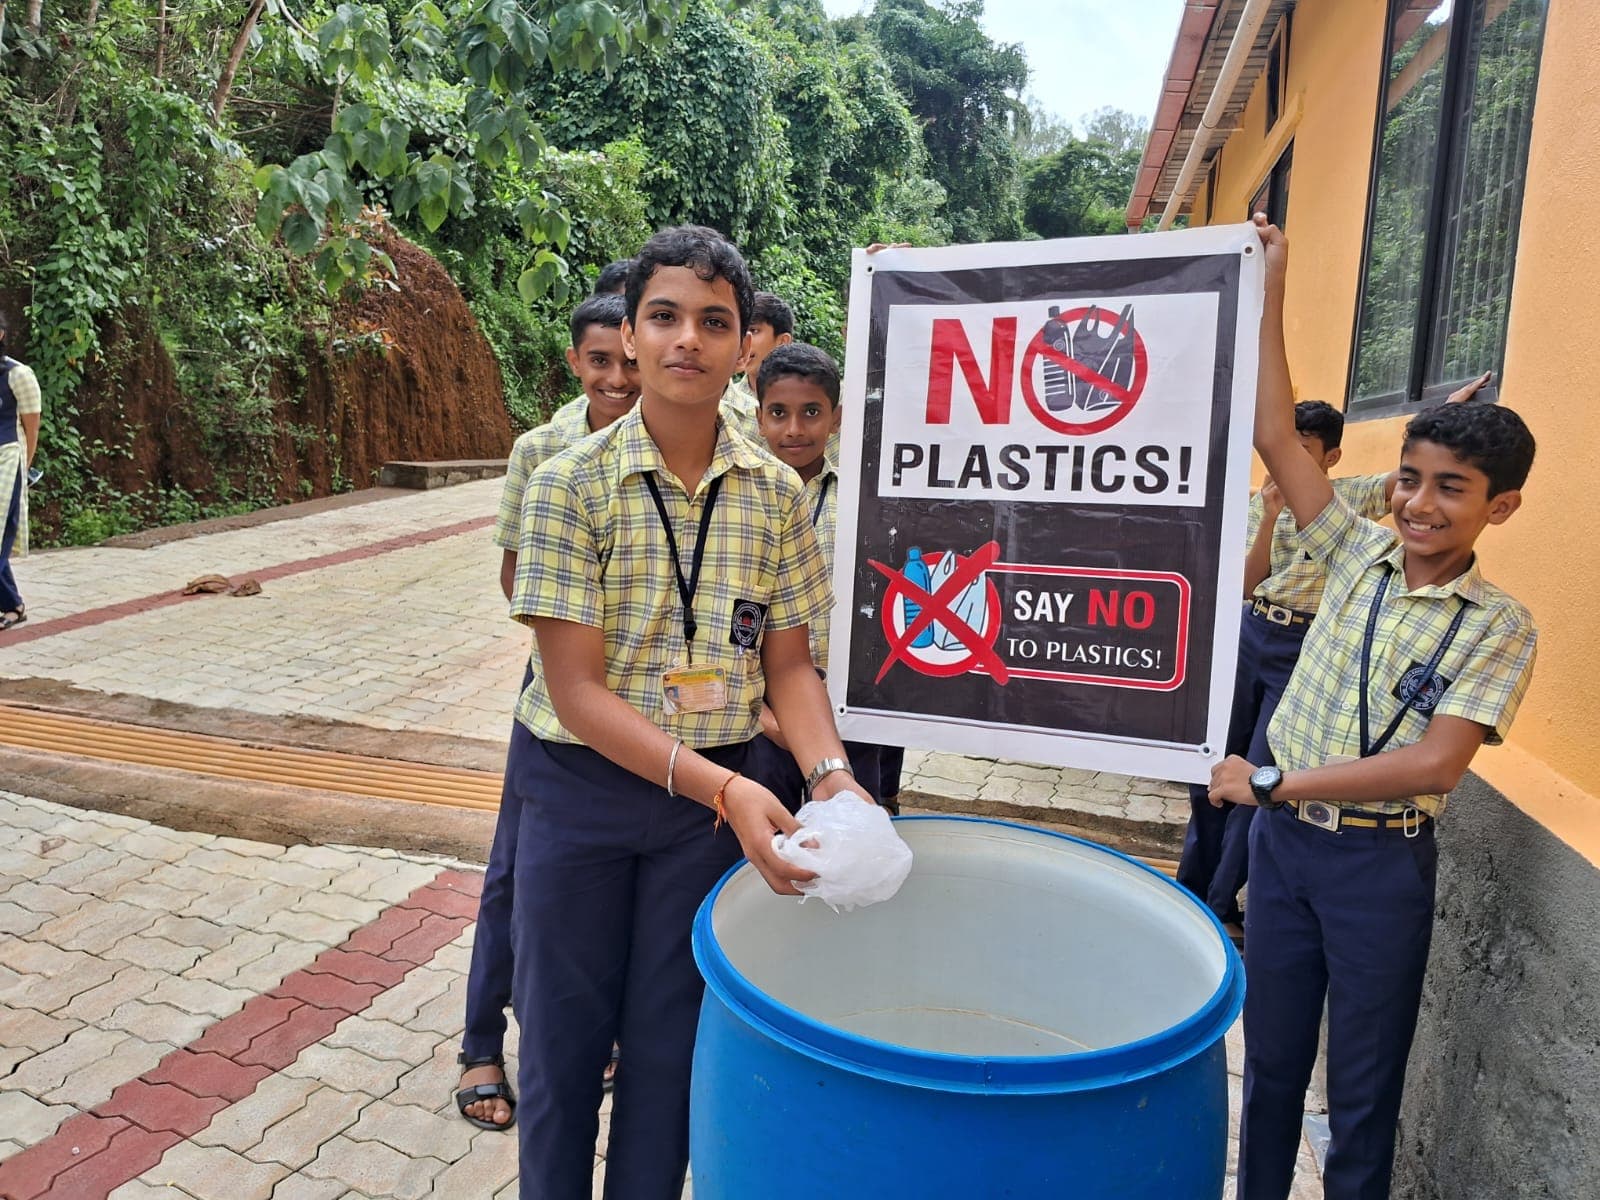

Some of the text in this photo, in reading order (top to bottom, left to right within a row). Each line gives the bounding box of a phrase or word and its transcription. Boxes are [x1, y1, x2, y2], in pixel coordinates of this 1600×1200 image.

[891, 443, 1192, 495] PLASTICS!
[1014, 588, 1155, 630] SAY NO
[1007, 638, 1162, 670] TO PLASTICS!
